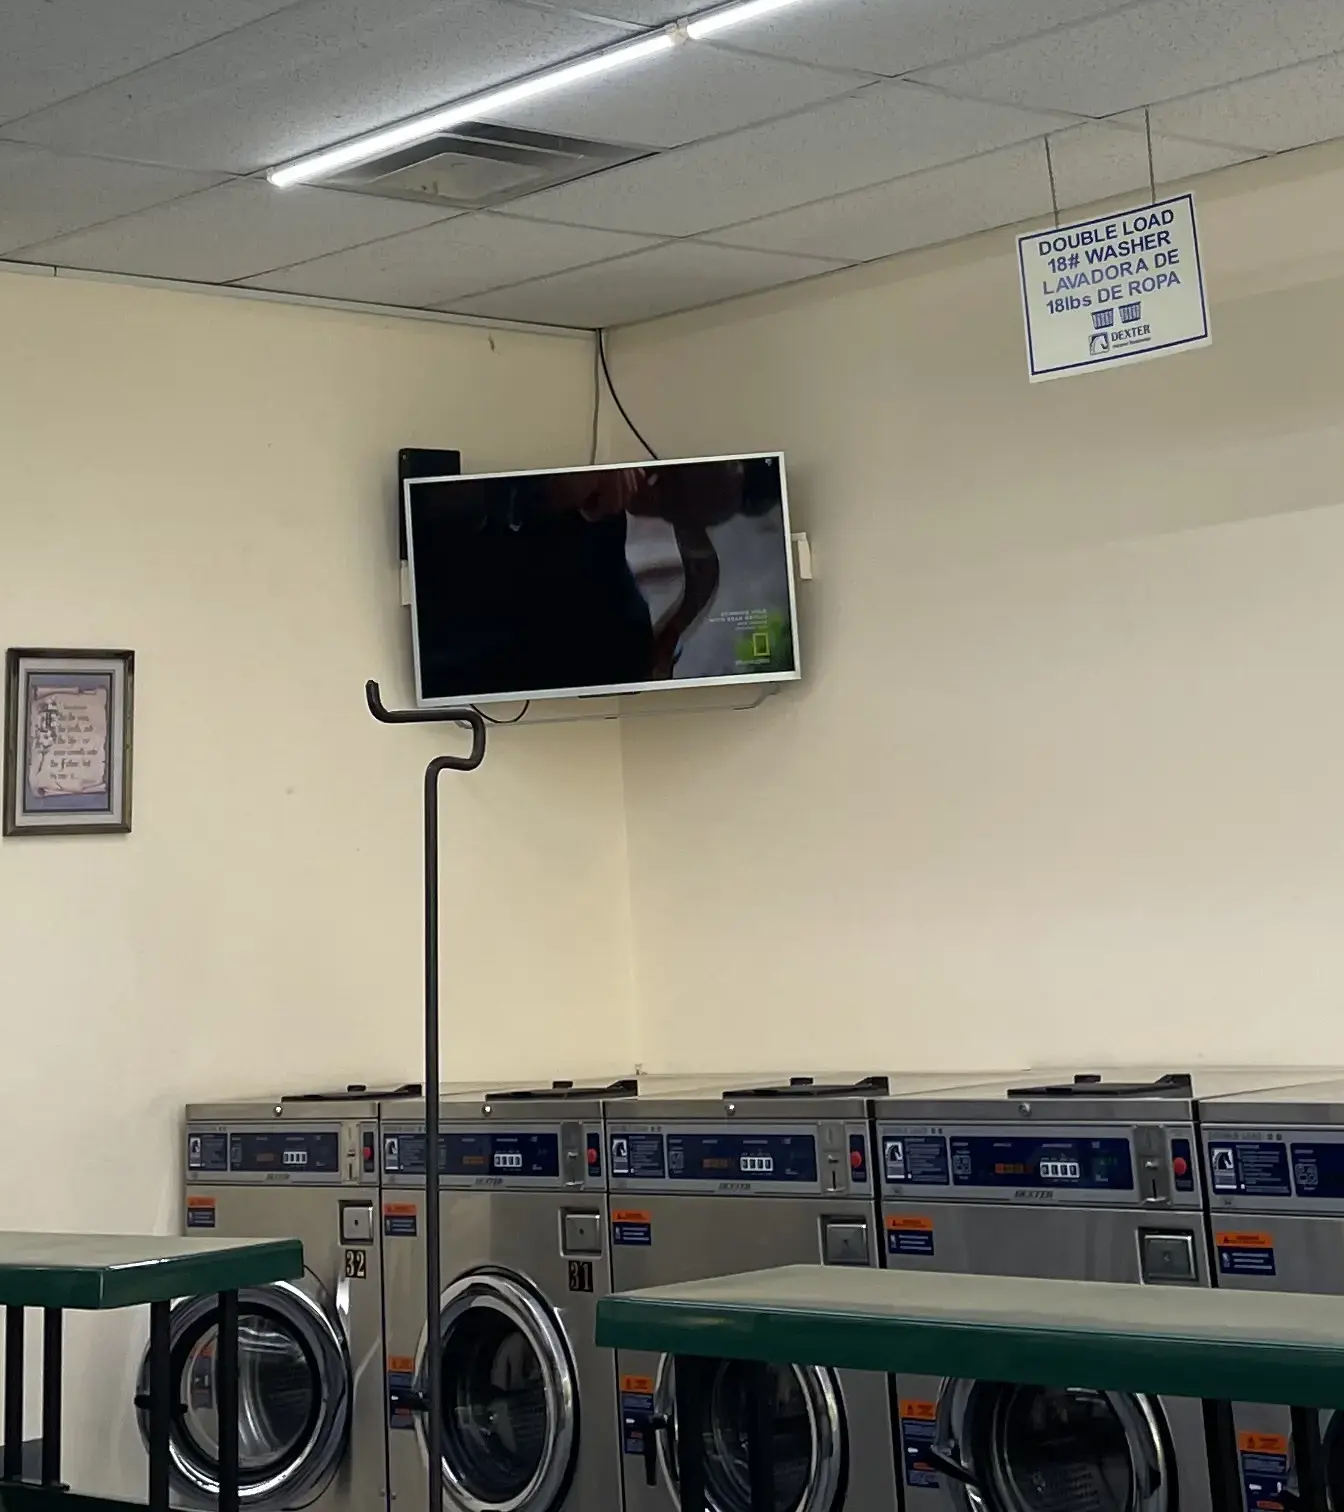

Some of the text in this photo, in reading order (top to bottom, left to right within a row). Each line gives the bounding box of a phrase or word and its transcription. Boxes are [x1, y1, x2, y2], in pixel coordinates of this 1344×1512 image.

[1039, 210, 1174, 256] DOUBLE LOAD
[1048, 231, 1171, 274] 18# WASHER
[1043, 249, 1179, 295] LAVADORA DE
[1047, 271, 1181, 315] 18lbs DE ROPA
[1111, 325, 1151, 342] DEXTER
[347, 1251, 365, 1277] 32
[570, 1263, 591, 1290] 31
